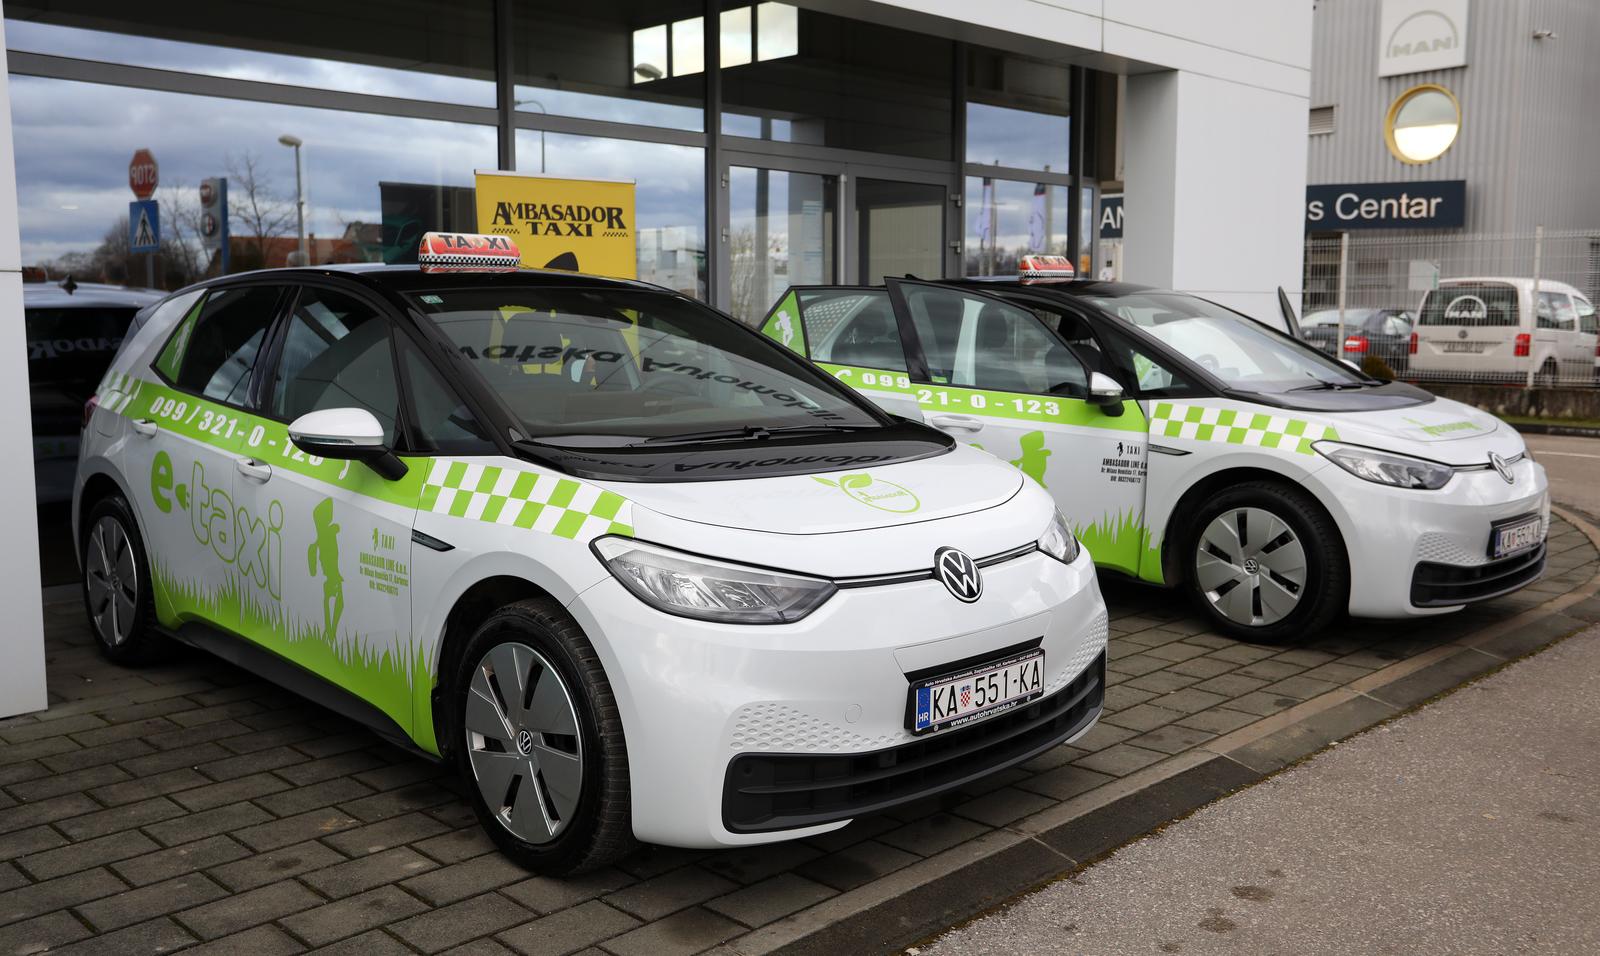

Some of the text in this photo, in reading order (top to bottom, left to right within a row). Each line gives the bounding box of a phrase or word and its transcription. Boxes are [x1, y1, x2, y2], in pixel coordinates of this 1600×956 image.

[1392, 37, 1451, 57] MAN
[492, 202, 626, 229] AMBASADOR
[1307, 200, 1324, 220] s
[1335, 193, 1442, 220] Centar
[525, 221, 593, 237] TAXI
[1449, 310, 1483, 318] MAN
[862, 372, 911, 388] 099
[1011, 398, 1060, 416] 123
[149, 396, 187, 421] 099
[1126, 445, 1140, 455] TAXI
[933, 685, 958, 721] KA
[951, 700, 1018, 727] www.autohrvatska.hr
[918, 711, 929, 723] HR
